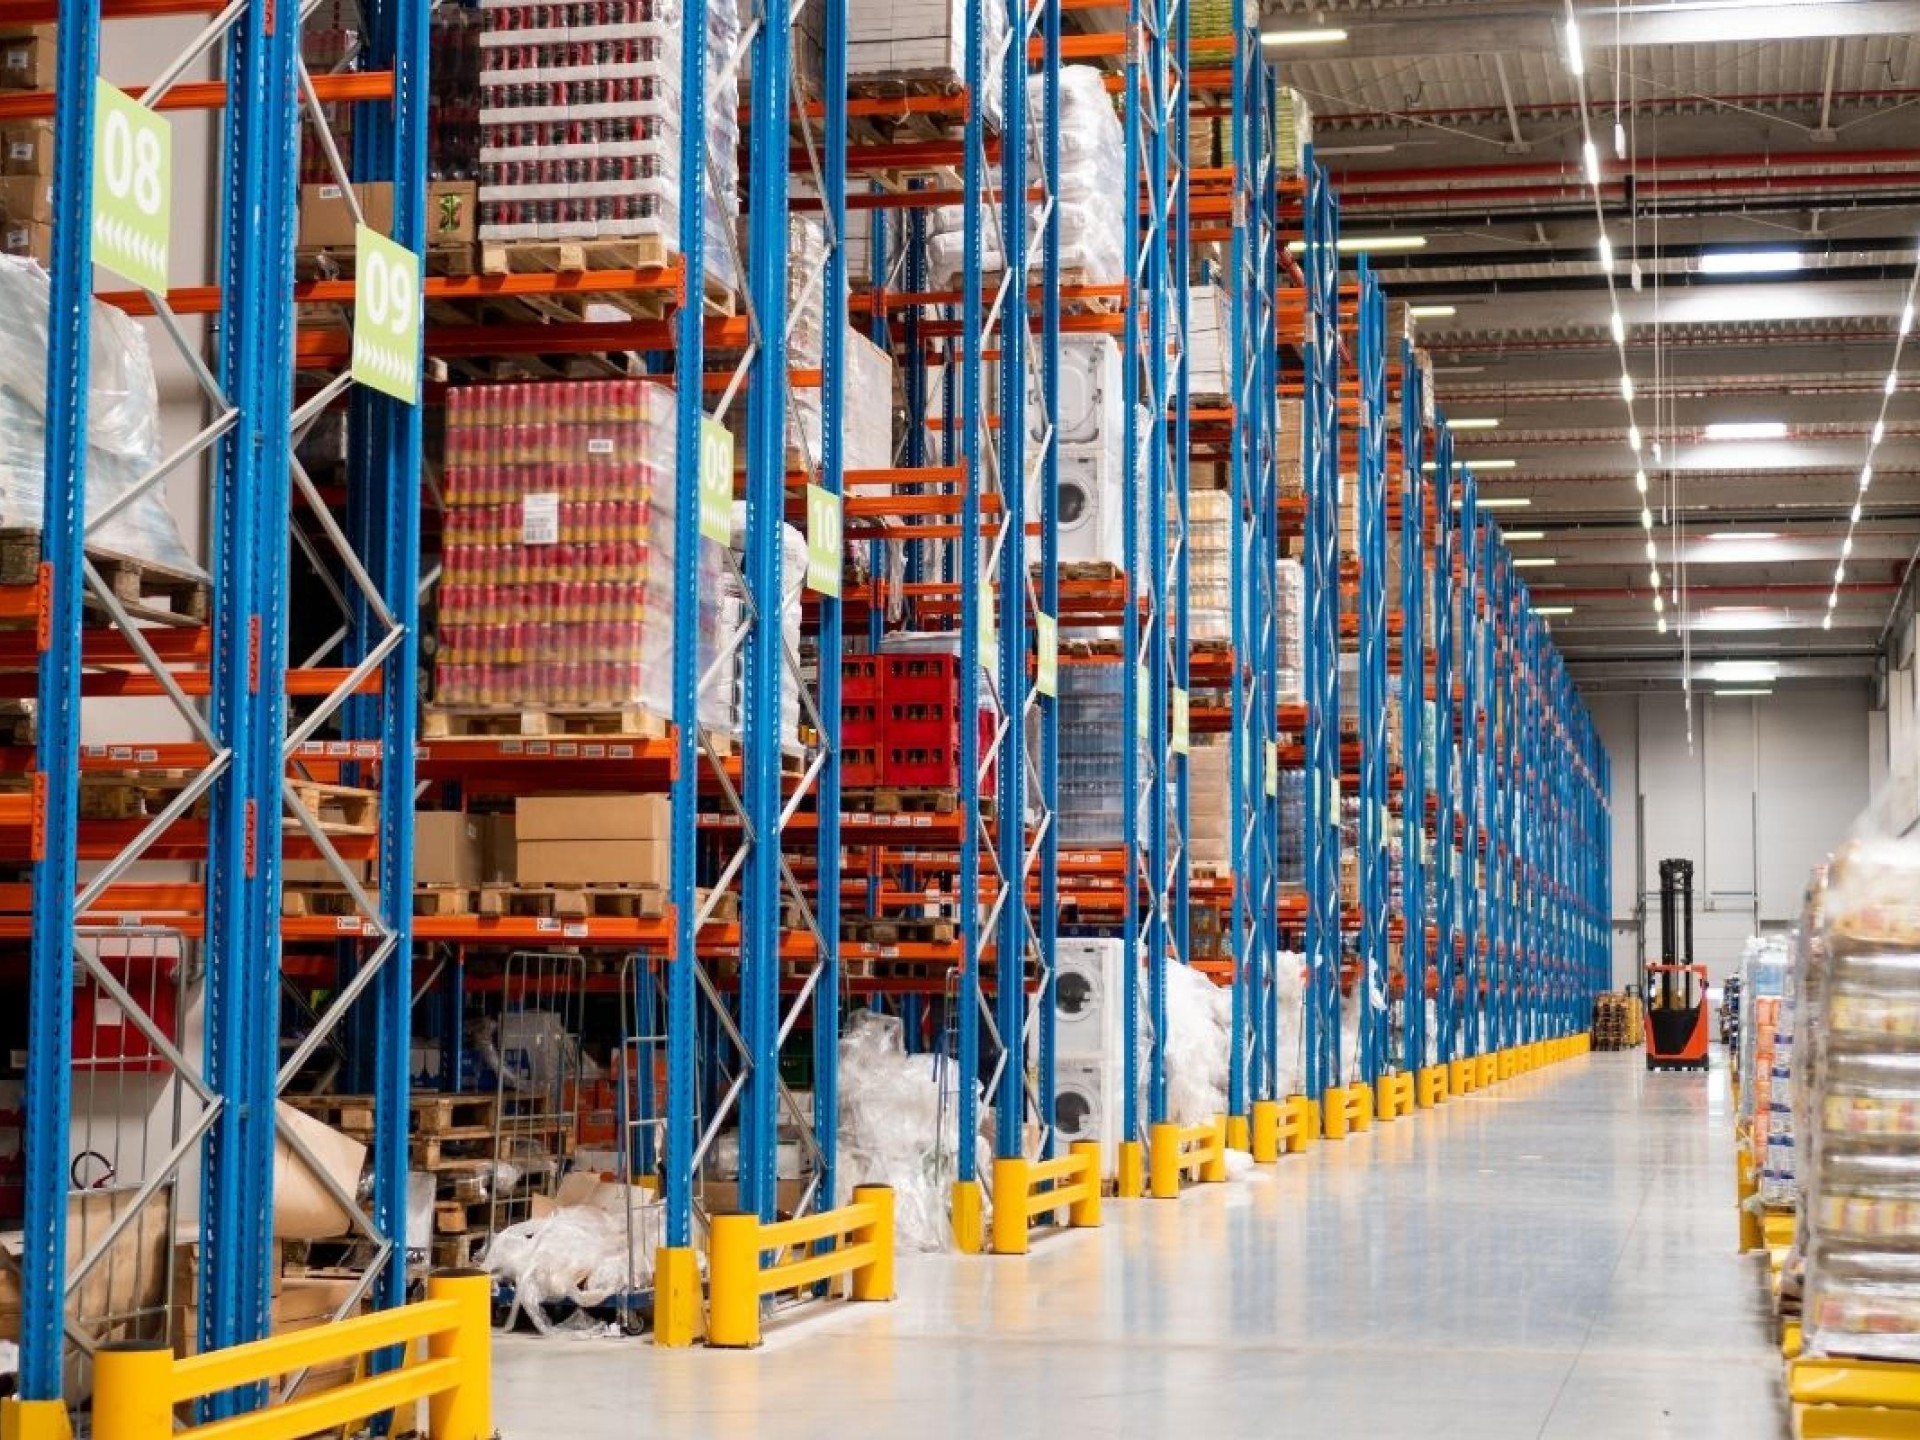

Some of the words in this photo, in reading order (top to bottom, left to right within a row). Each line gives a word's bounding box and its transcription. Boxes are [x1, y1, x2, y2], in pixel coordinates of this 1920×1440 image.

[104, 108, 161, 216] 08
[366, 251, 411, 335] 09
[707, 437, 730, 495] 09
[814, 500, 837, 553] 10
